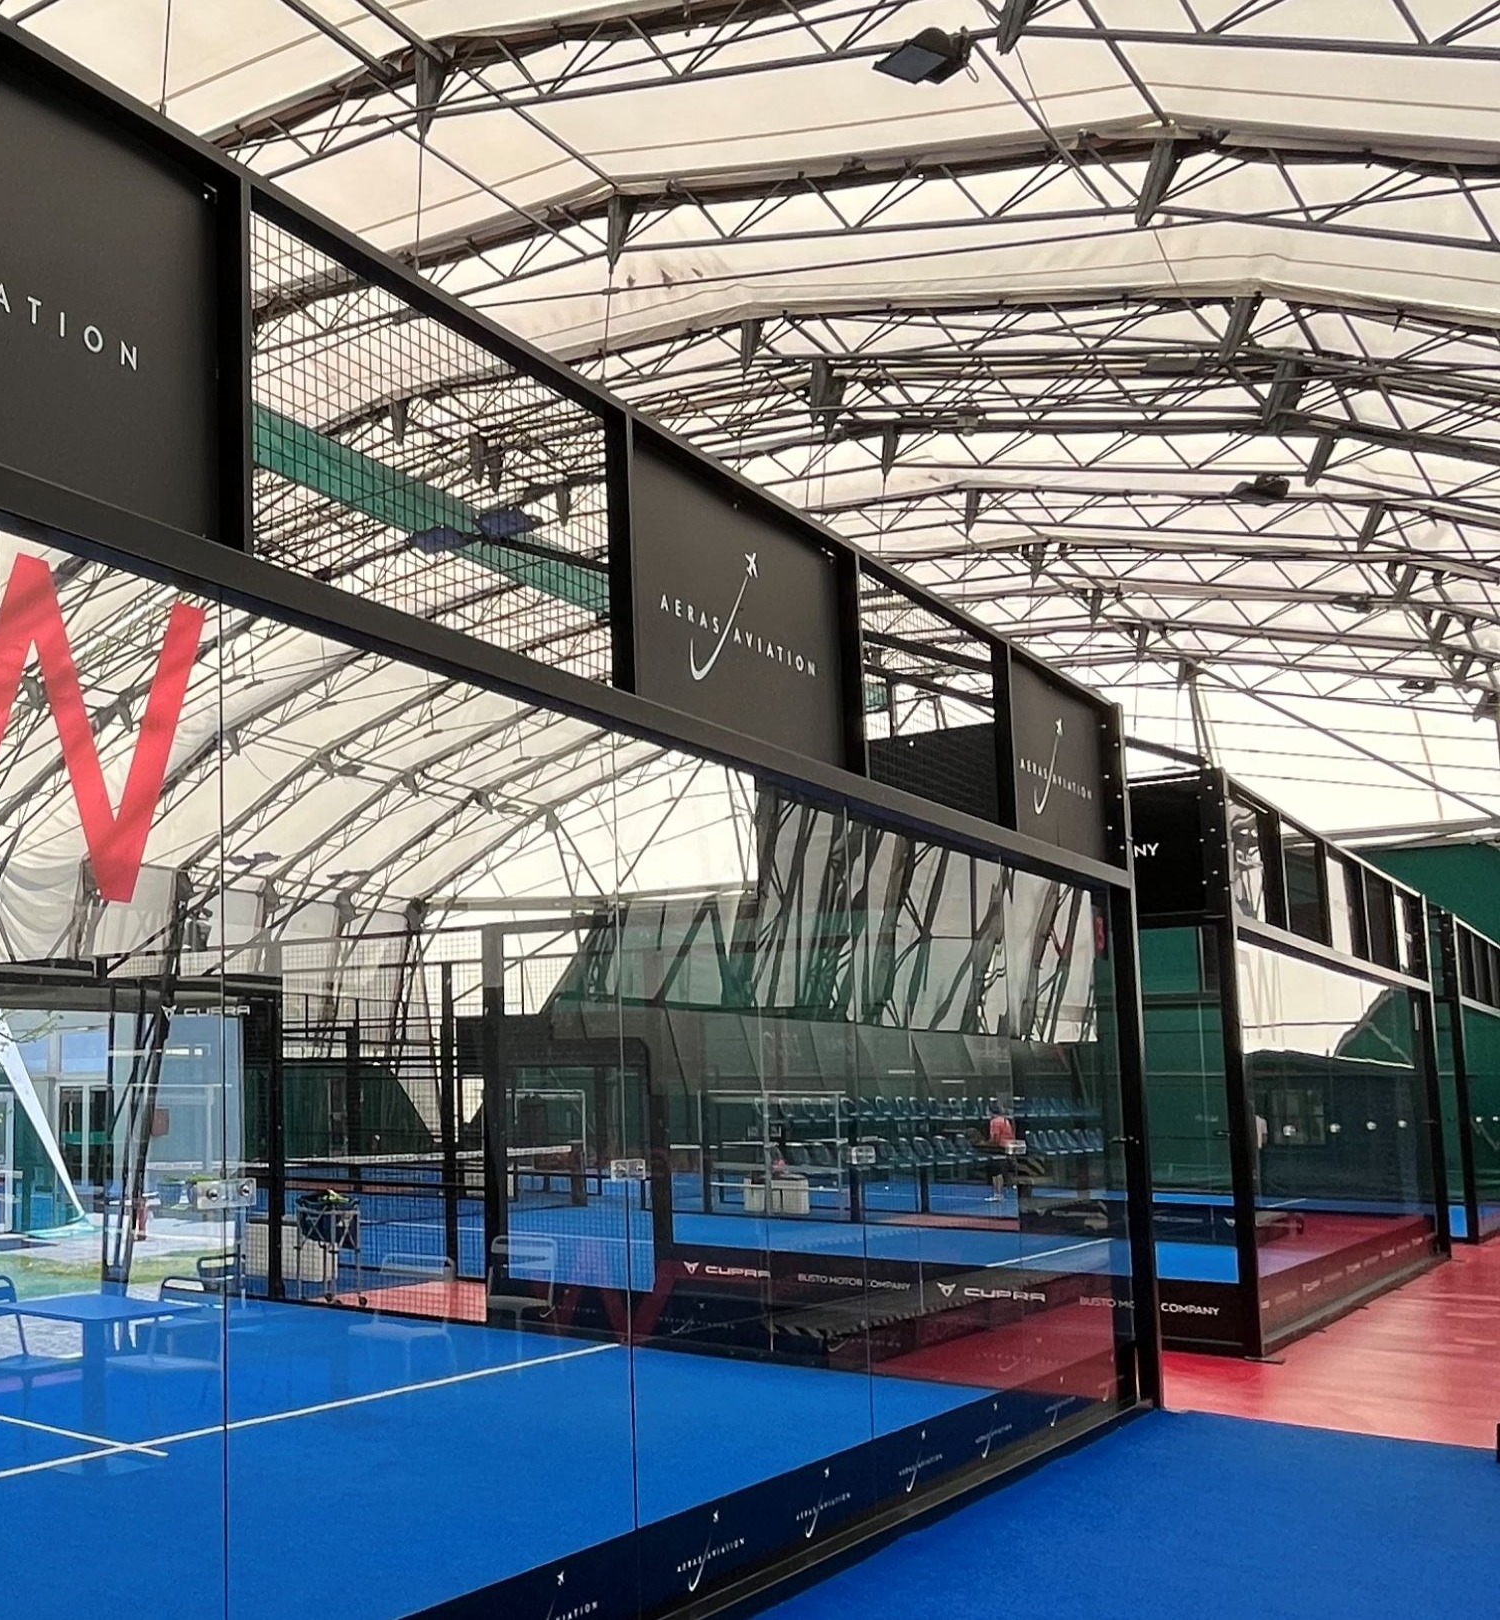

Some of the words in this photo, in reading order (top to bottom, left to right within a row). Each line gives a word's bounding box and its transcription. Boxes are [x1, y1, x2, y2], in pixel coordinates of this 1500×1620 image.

[660, 594, 720, 634] AERAS
[733, 627, 816, 677] AVIATION
[1020, 758, 1048, 780] AERAS
[704, 1265, 771, 1279] CUPRA
[963, 1286, 1047, 1303] CUPRA
[1160, 1302, 1220, 1317] COMPANY
